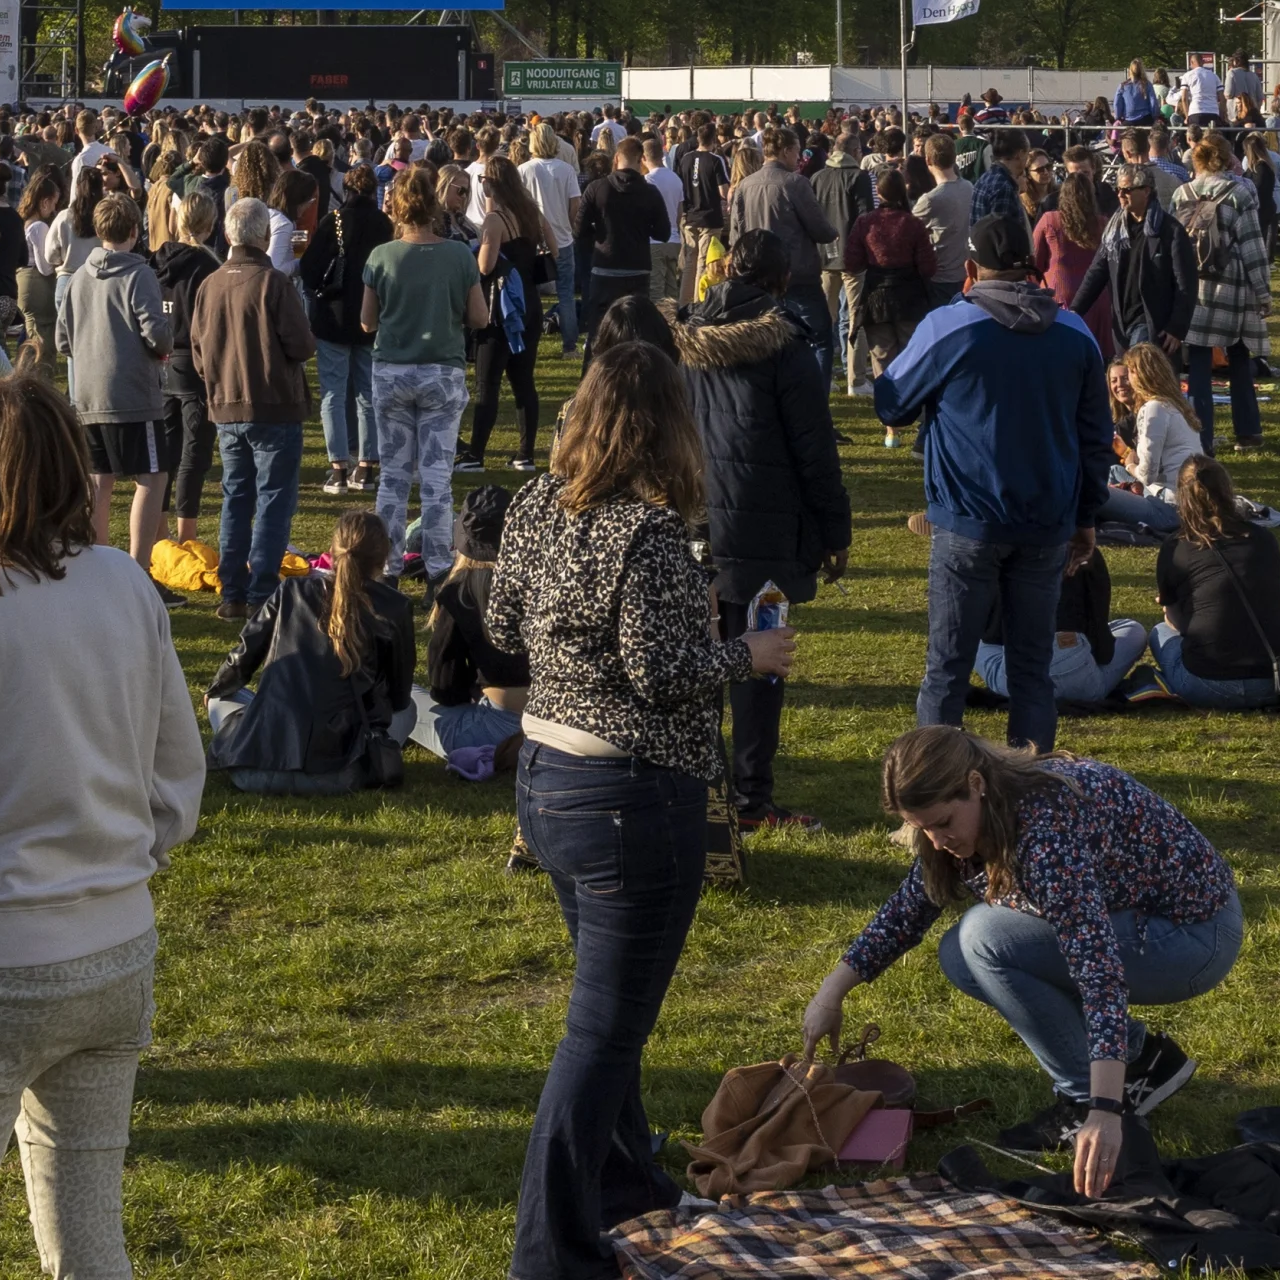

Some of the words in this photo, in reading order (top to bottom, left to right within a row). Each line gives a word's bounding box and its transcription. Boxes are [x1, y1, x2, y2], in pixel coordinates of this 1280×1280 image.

[922, 7, 946, 19] Den
[525, 68, 601, 79] NOODUITGANG
[309, 74, 349, 85] FABER
[525, 80, 574, 90] VRIJLATEN
[574, 80, 601, 90] A.U.B.
